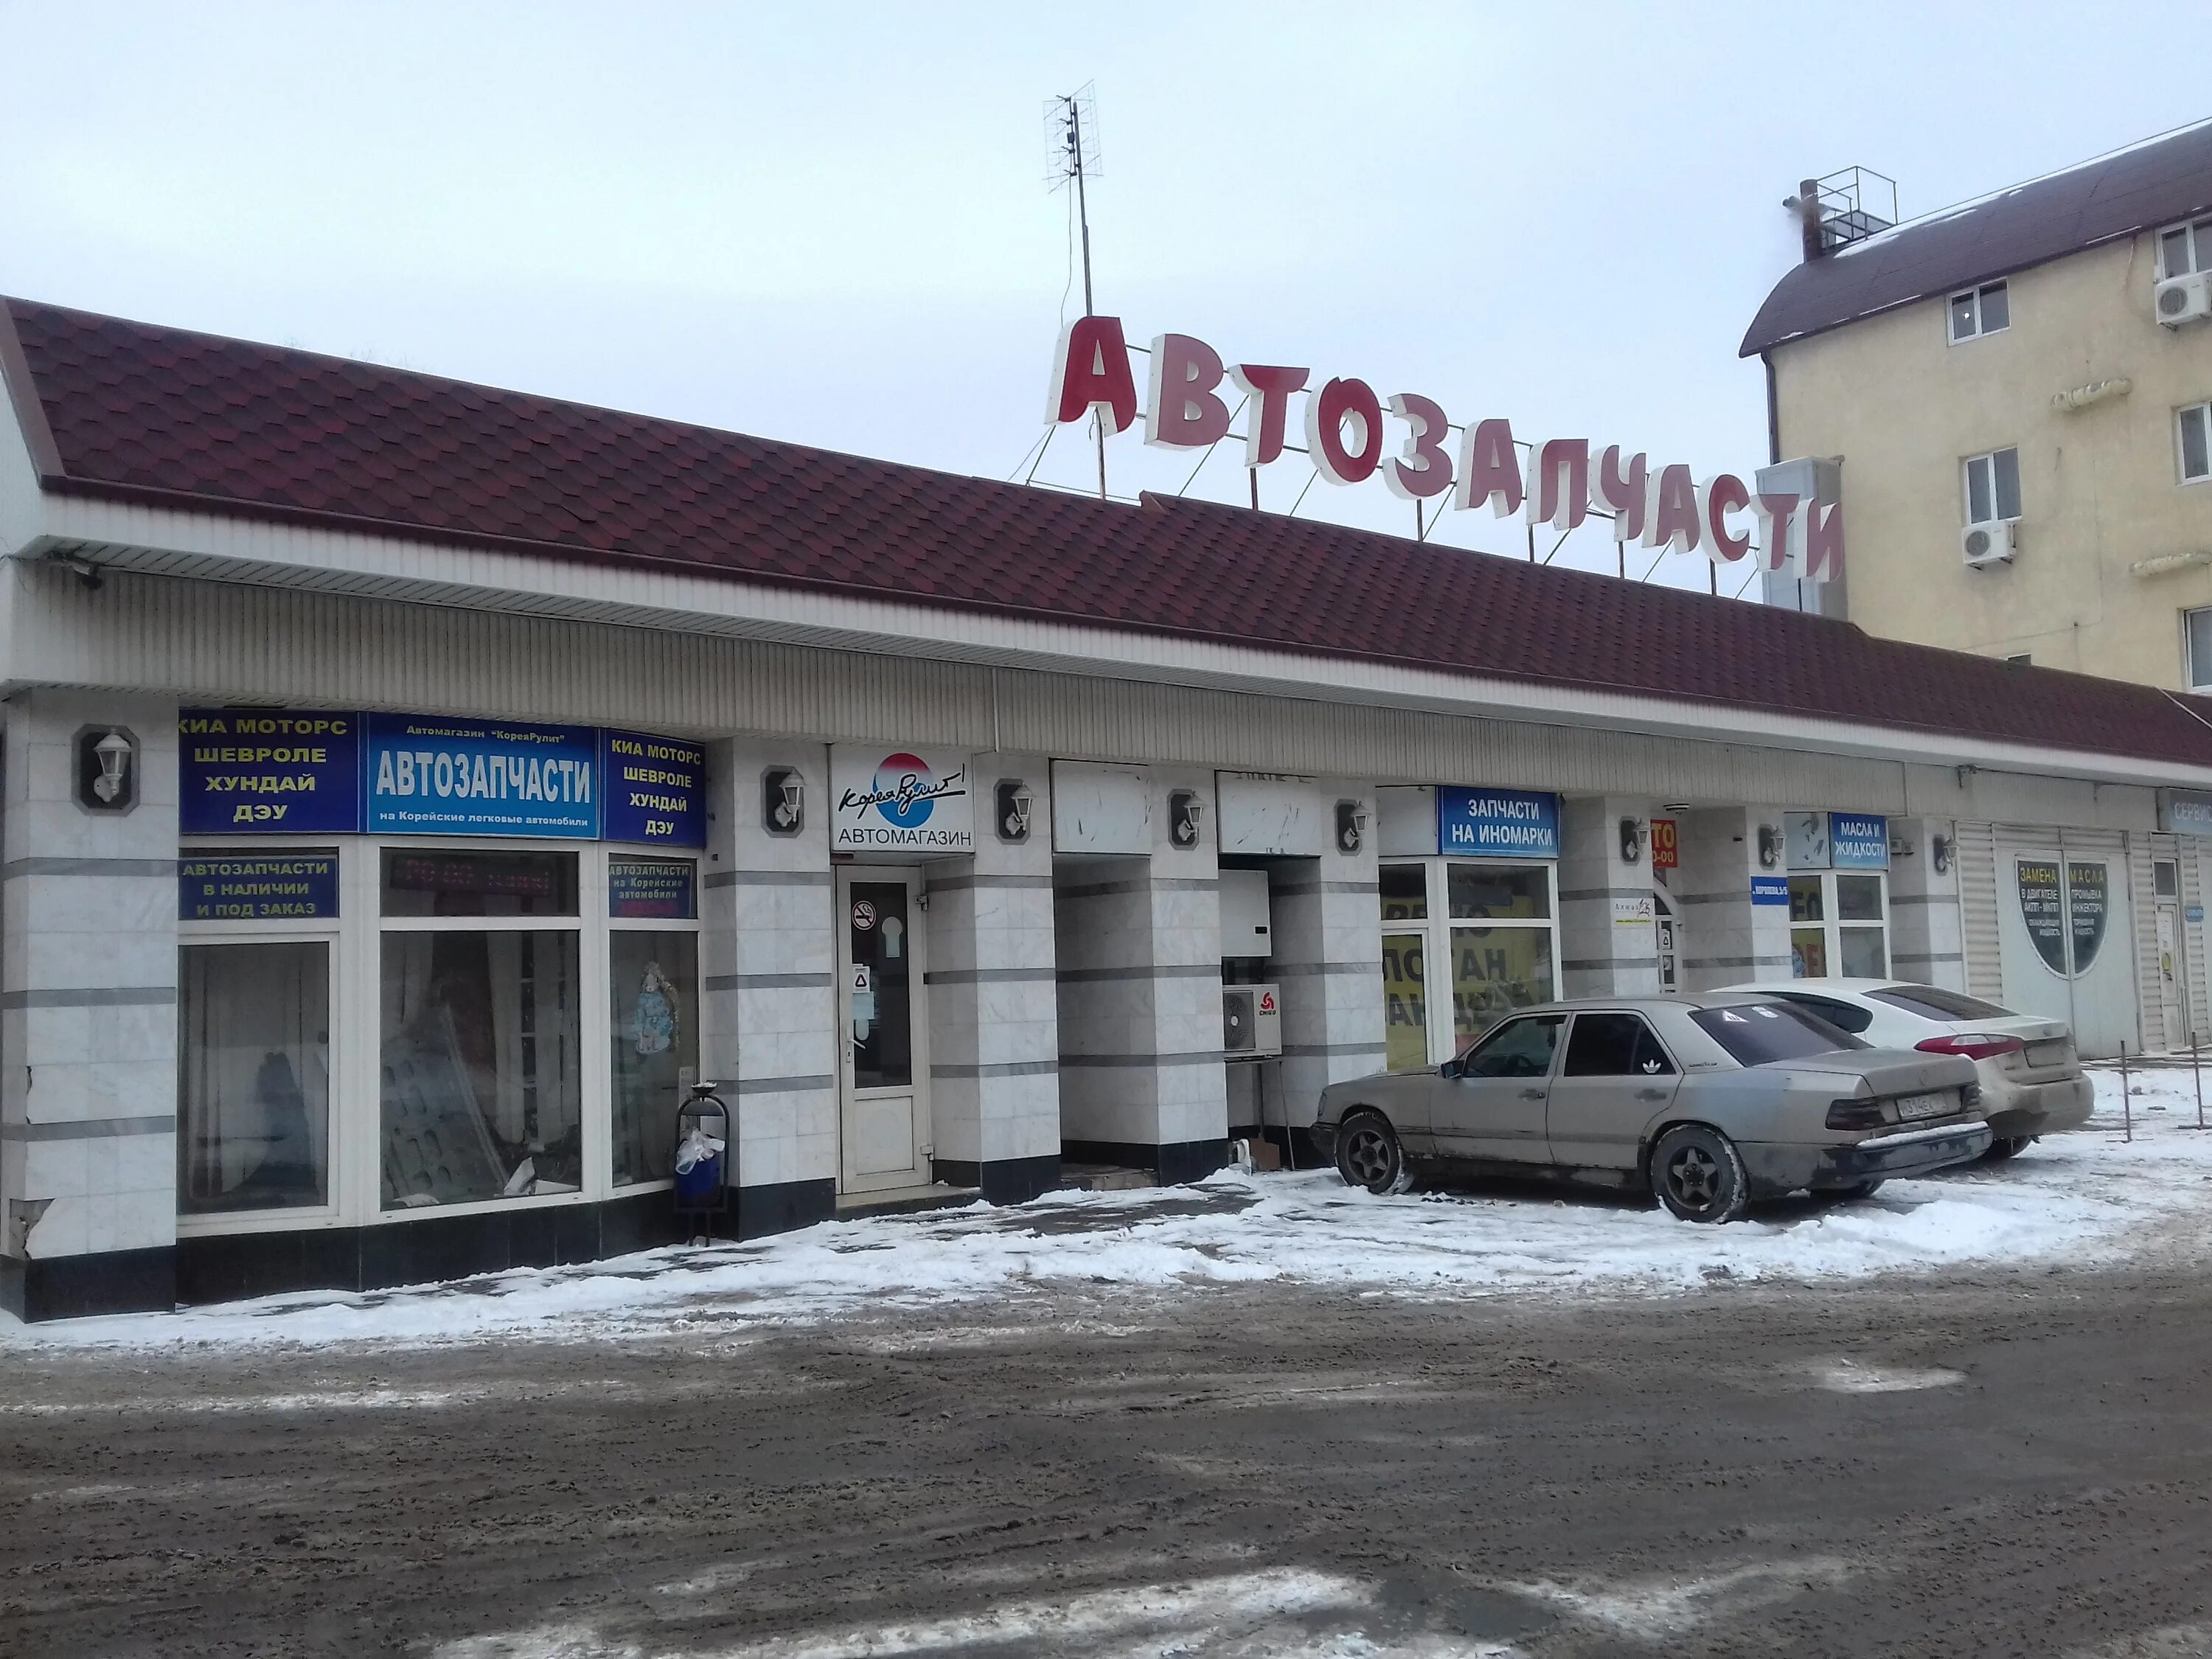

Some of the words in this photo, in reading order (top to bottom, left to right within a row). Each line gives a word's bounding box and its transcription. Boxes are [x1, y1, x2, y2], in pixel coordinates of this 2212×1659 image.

[1044, 315, 1842, 583] АВТОЗАПЧАСТИ
[236, 720, 347, 734] МОТОРС
[406, 726, 485, 738] Автомагазин
[194, 748, 327, 763] ШЕВРОЛЕ
[611, 739, 643, 757] КИА
[647, 744, 701, 765] МОТОРС
[205, 773, 316, 793] ХУНДАЙ
[376, 751, 591, 804] АВТОЗАПЧАСТИ
[623, 766, 692, 788] ШЕВРОЛЕ
[630, 793, 687, 812] ХУНДАЙ
[1467, 799, 1540, 821] ЗАПЧАСТИ
[233, 805, 288, 823] ДЭУ
[380, 813, 395, 821] на
[399, 811, 465, 822] Корейские
[468, 815, 522, 824] легковые
[525, 816, 588, 827] автомобили
[645, 820, 675, 835] ДЭУ
[1451, 824, 1475, 844] НА
[1478, 824, 1552, 846] ИНОМАРКИ
[1840, 821, 1872, 838] МАСЛА
[1874, 824, 1879, 838] И
[838, 828, 971, 846] АВТОМАГАЗИН
[1834, 841, 1887, 858] ЖИДКОСТИ
[182, 862, 328, 876] АВТОЗАПЧАСТИ
[608, 865, 689, 877] АВТОЗАПЧАСТИ
[2020, 867, 2057, 883] ЗАМЕНА
[2070, 869, 2104, 883] МАСЛА
[203, 884, 215, 896] В
[220, 883, 310, 896] НАЛИЧИИ
[619, 888, 677, 899] автомобили
[196, 904, 209, 917] И
[215, 903, 254, 918] ПОД
[260, 902, 317, 915] ЗАКАЗ
